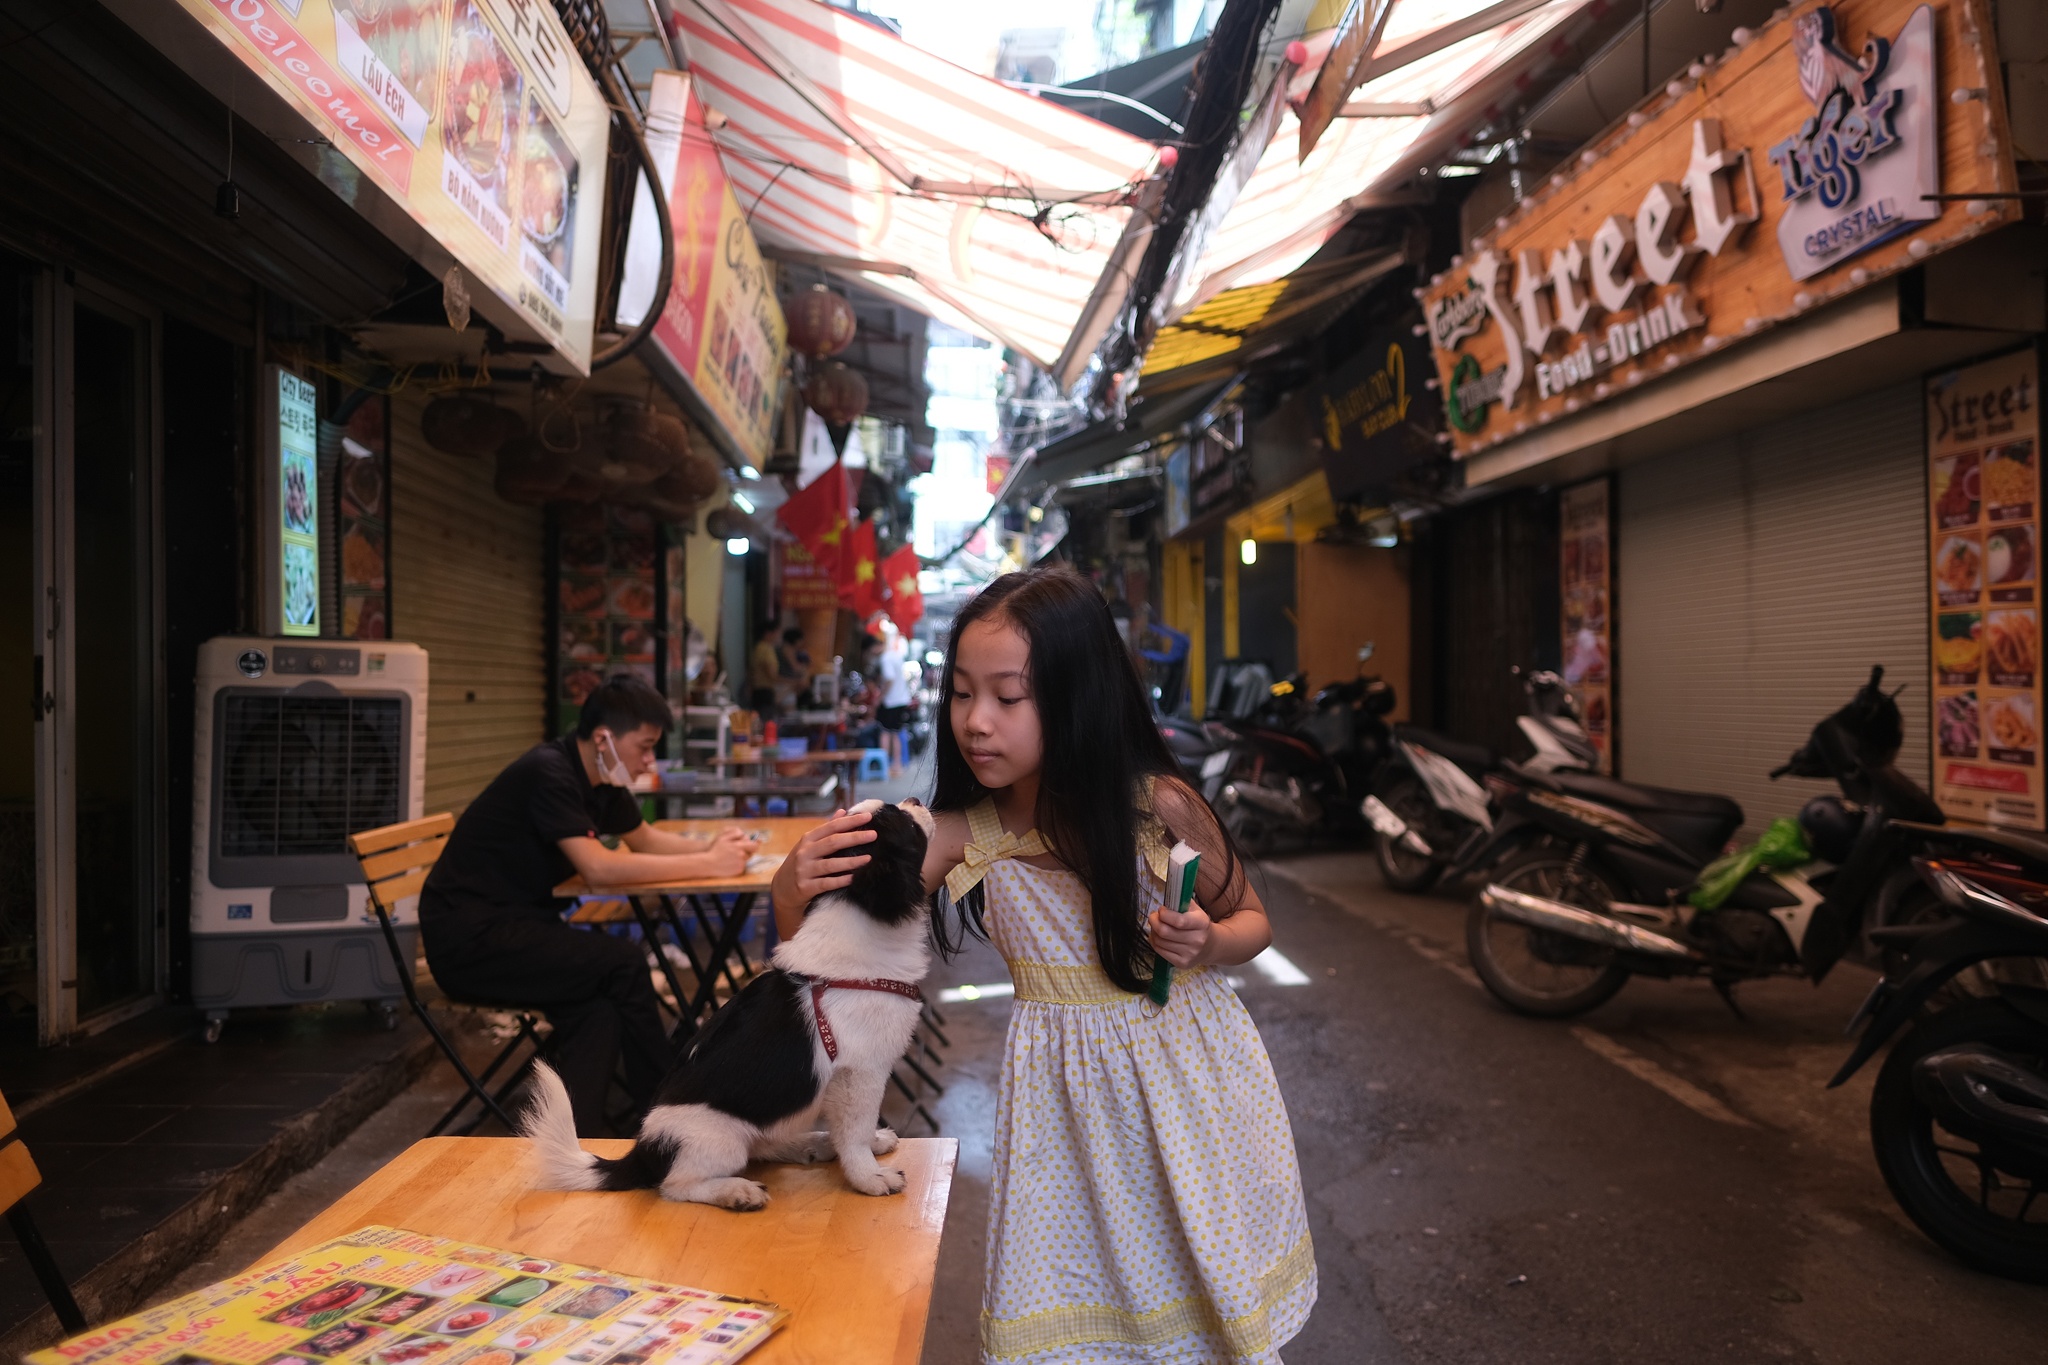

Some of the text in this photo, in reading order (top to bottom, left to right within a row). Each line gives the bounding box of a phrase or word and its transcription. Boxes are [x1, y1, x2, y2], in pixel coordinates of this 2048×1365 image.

[1768, 87, 1899, 209] Tiger
[1804, 199, 1894, 257] CRYSTAL
[1469, 118, 1742, 411] Street
[1930, 375, 2031, 443] Street
[253, 1275, 336, 1315] HOTPOT
